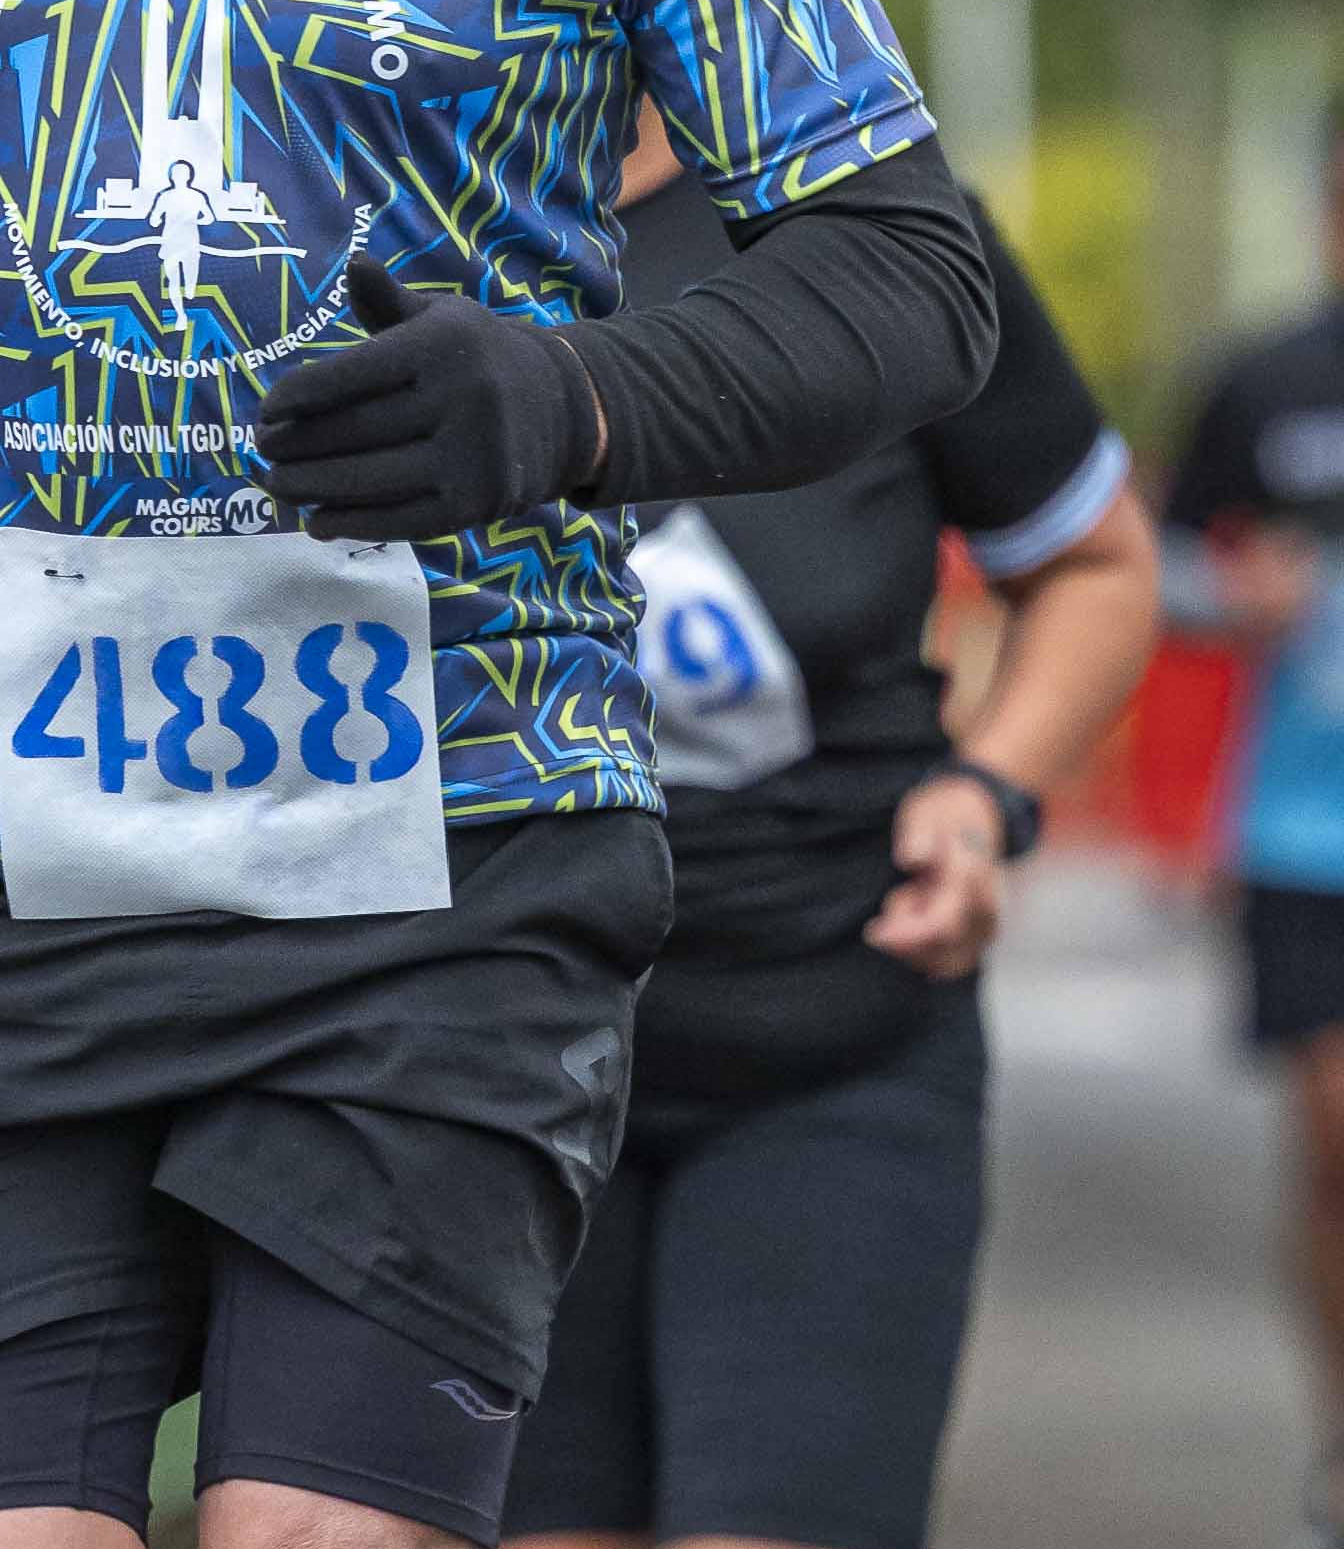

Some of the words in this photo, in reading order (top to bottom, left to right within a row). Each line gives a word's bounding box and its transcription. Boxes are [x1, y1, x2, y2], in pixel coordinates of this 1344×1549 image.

[3, 203, 84, 348] MOVIMIENTO,
[89, 338, 220, 379] INCLUSIÓN
[223, 355, 238, 373] Y
[243, 306, 336, 370] ENERGÍA
[327, 203, 372, 308] POTIVA
[4, 415, 114, 453] ASOCIACIÓN
[119, 424, 176, 454] CIVIL
[177, 423, 224, 454] TGD
[230, 424, 257, 454] PA
[136, 497, 222, 516] MAGNY
[150, 517, 223, 535] COURS
[640, 593, 759, 715] 9
[11, 621, 424, 794] 488
